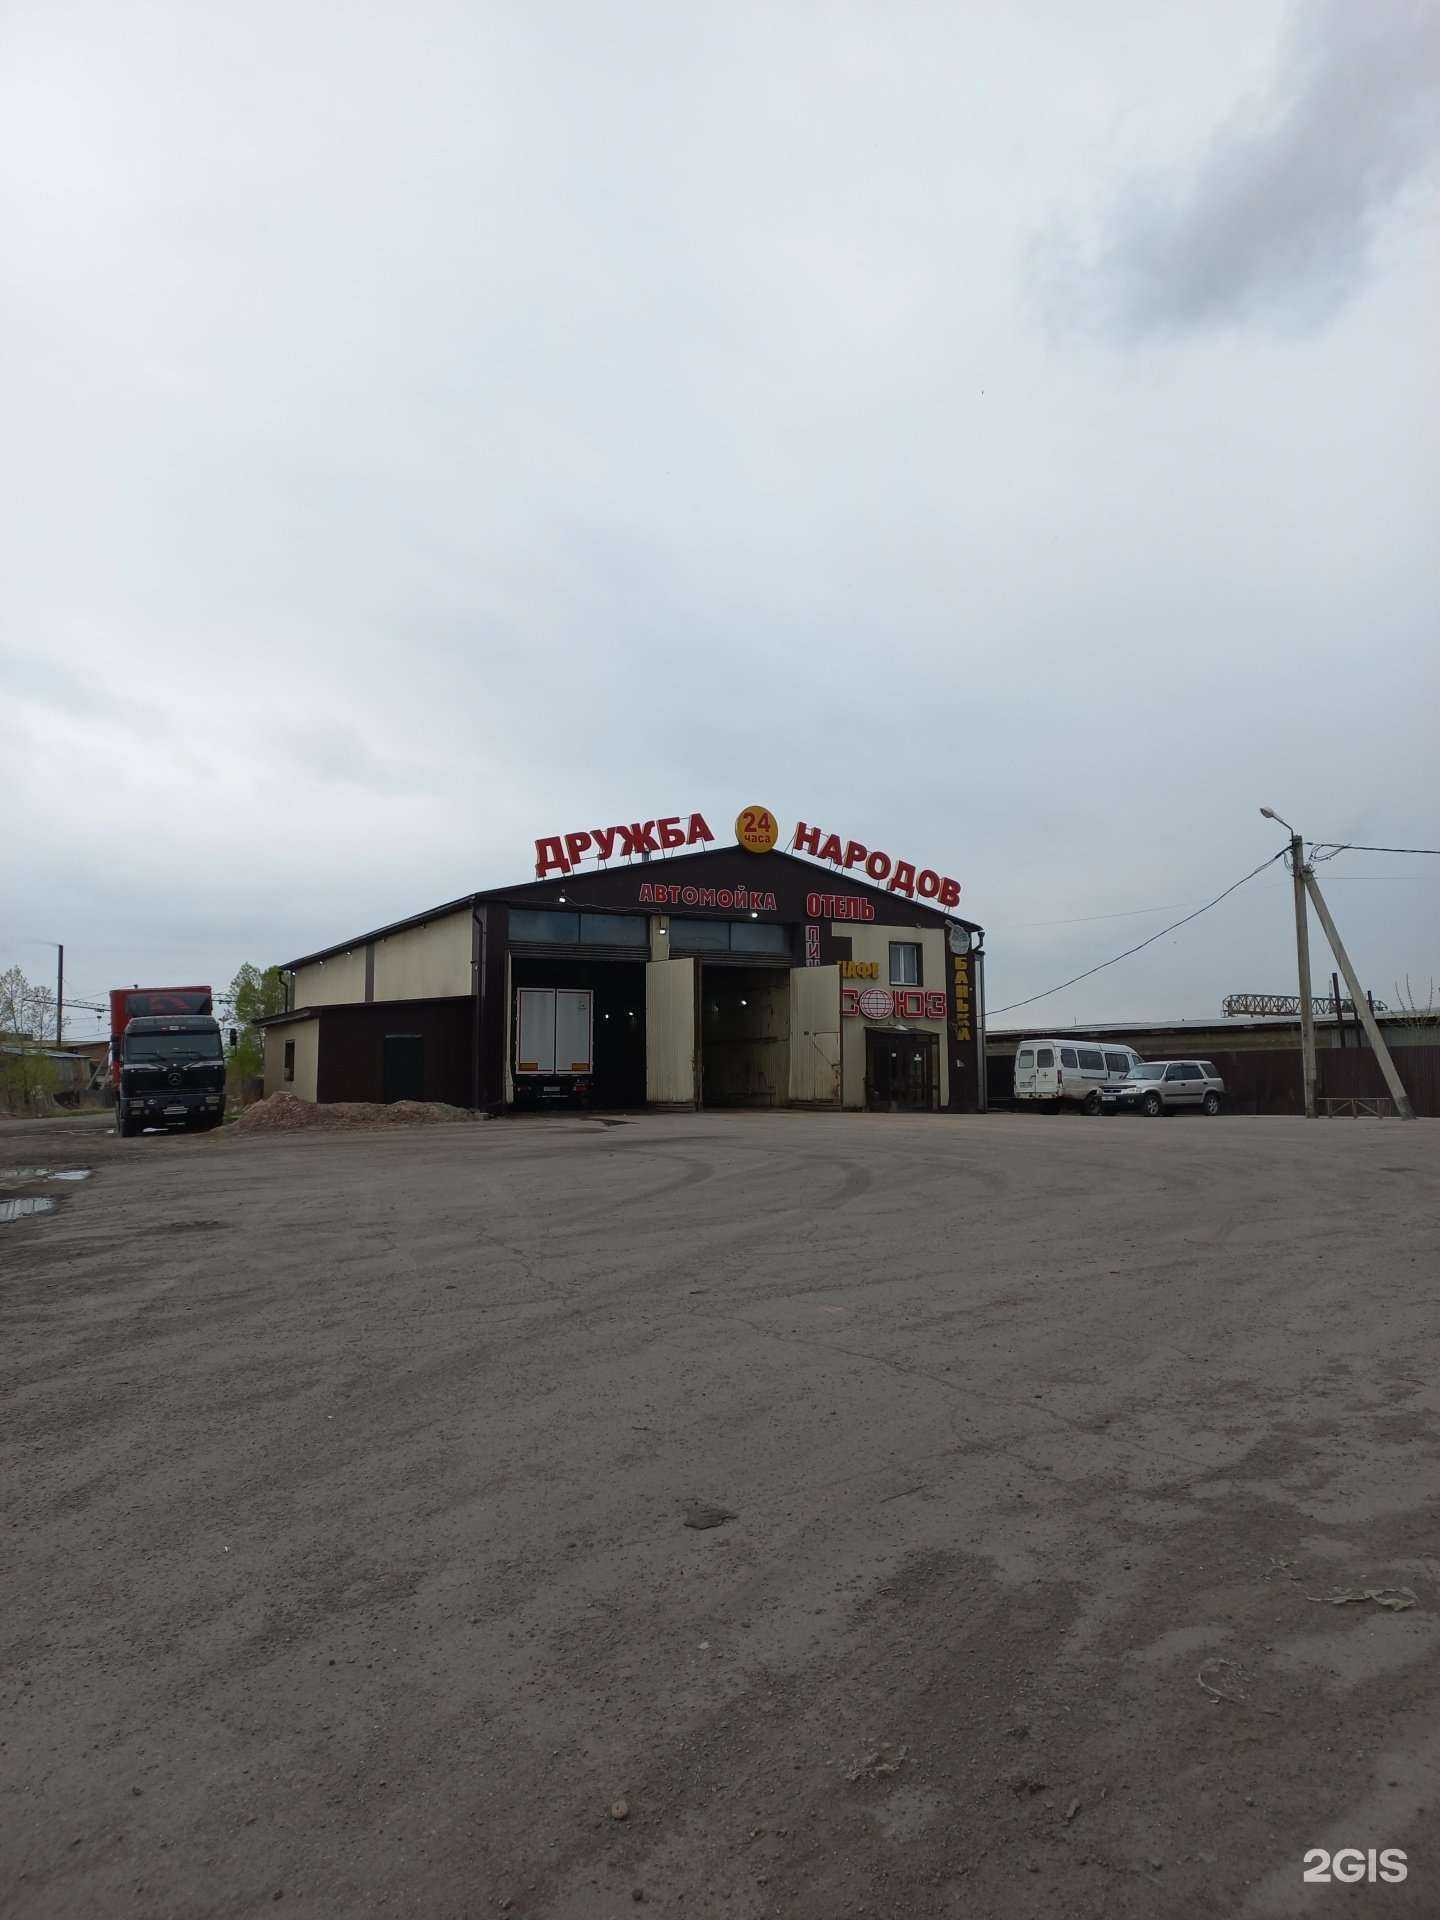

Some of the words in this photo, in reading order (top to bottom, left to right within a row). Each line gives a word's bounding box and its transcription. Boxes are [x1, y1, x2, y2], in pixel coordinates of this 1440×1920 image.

[742, 812, 771, 833] 24
[743, 834, 771, 843] часа
[535, 813, 715, 878] ДРУЖБА
[793, 821, 962, 907] НАРОДОВ
[639, 883, 777, 911] АВТОМОЙКА
[806, 892, 875, 921] ОТЕЛЬ
